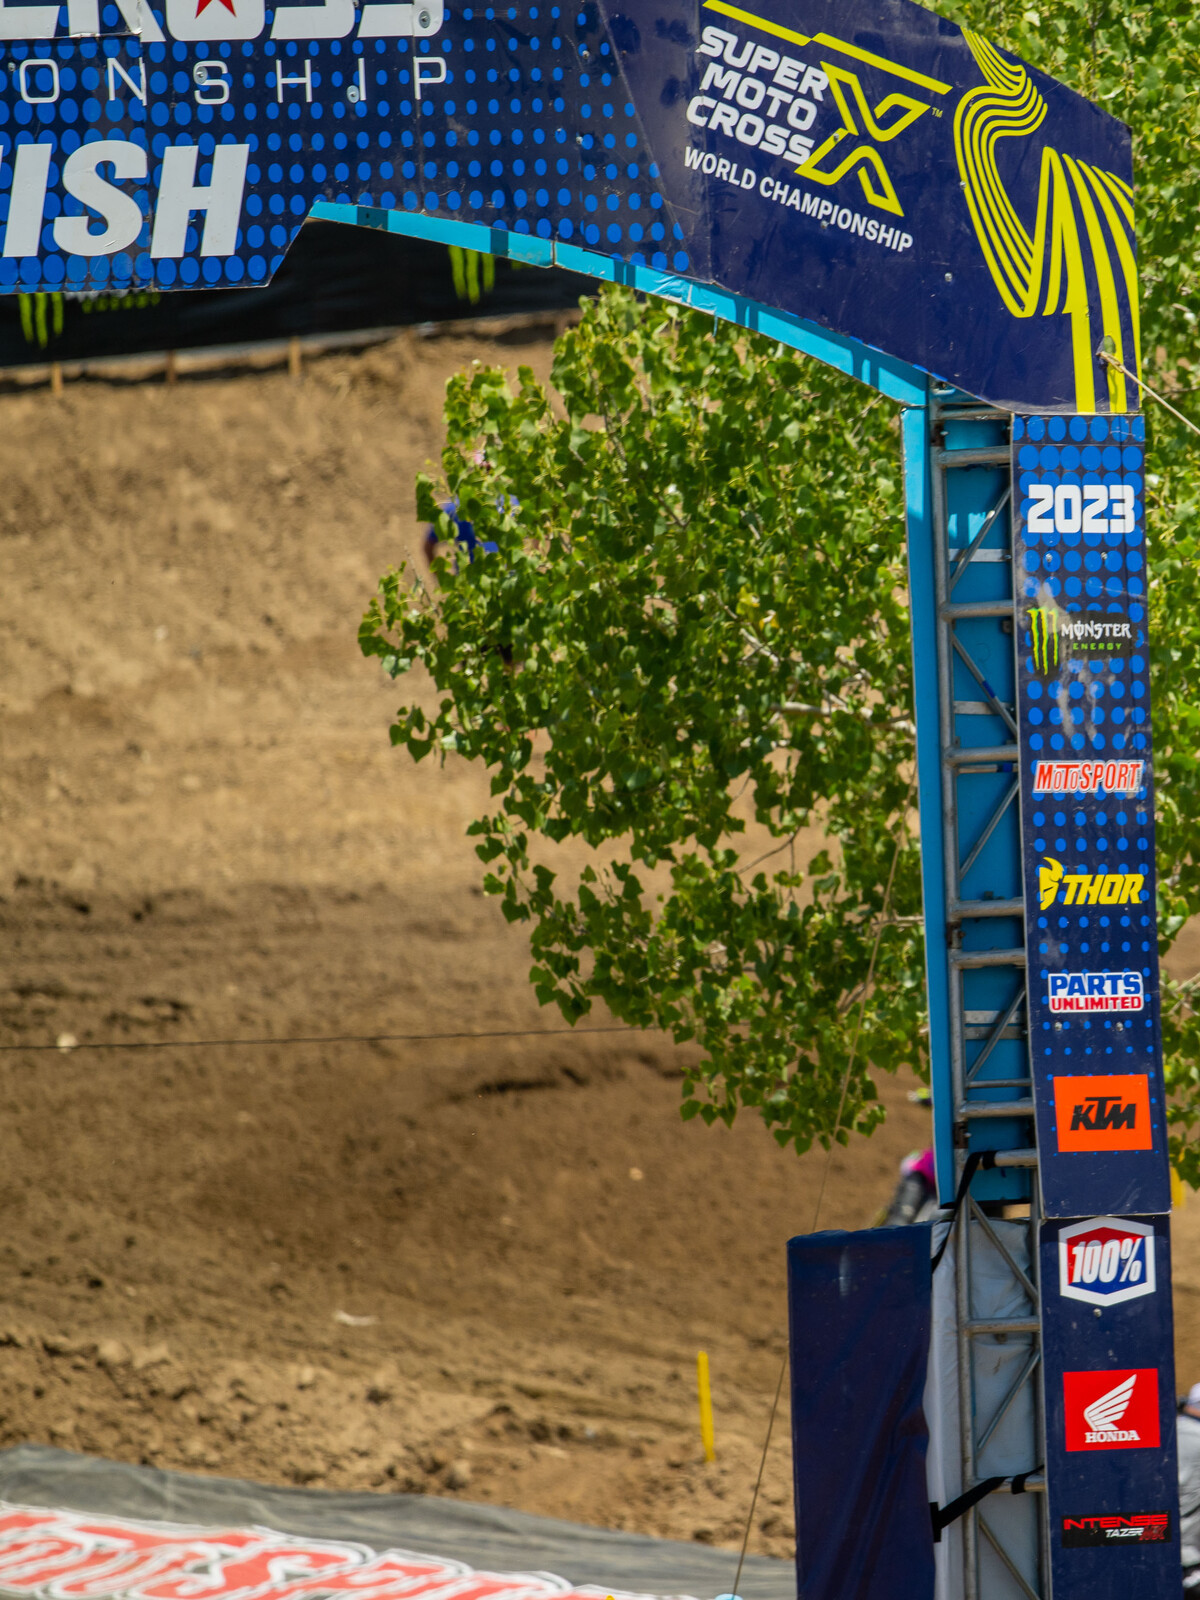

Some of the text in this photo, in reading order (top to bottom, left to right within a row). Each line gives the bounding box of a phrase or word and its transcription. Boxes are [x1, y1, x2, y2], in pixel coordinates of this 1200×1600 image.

[696, 26, 830, 102] SUPER
[699, 62, 818, 131] MOTO
[686, 96, 815, 165] CROSS
[0, 139, 250, 259] ISH
[684, 146, 914, 253] WORLD CHAMPIONSHIP
[1027, 484, 1136, 534] 2023
[1061, 620, 1132, 640] MONSTER
[1072, 643, 1122, 651] ENERGY
[1036, 763, 1141, 791] MOTOSPORT
[1062, 873, 1145, 906] THOR
[1051, 973, 1141, 997] PARTS
[1052, 995, 1143, 1011] UNLIMITED
[1069, 1096, 1137, 1131] KTM
[1071, 1236, 1143, 1284] 100%
[1085, 1430, 1141, 1444] HONDA
[1063, 1514, 1169, 1530] INTENSE
[1105, 1527, 1144, 1538] TAZER
